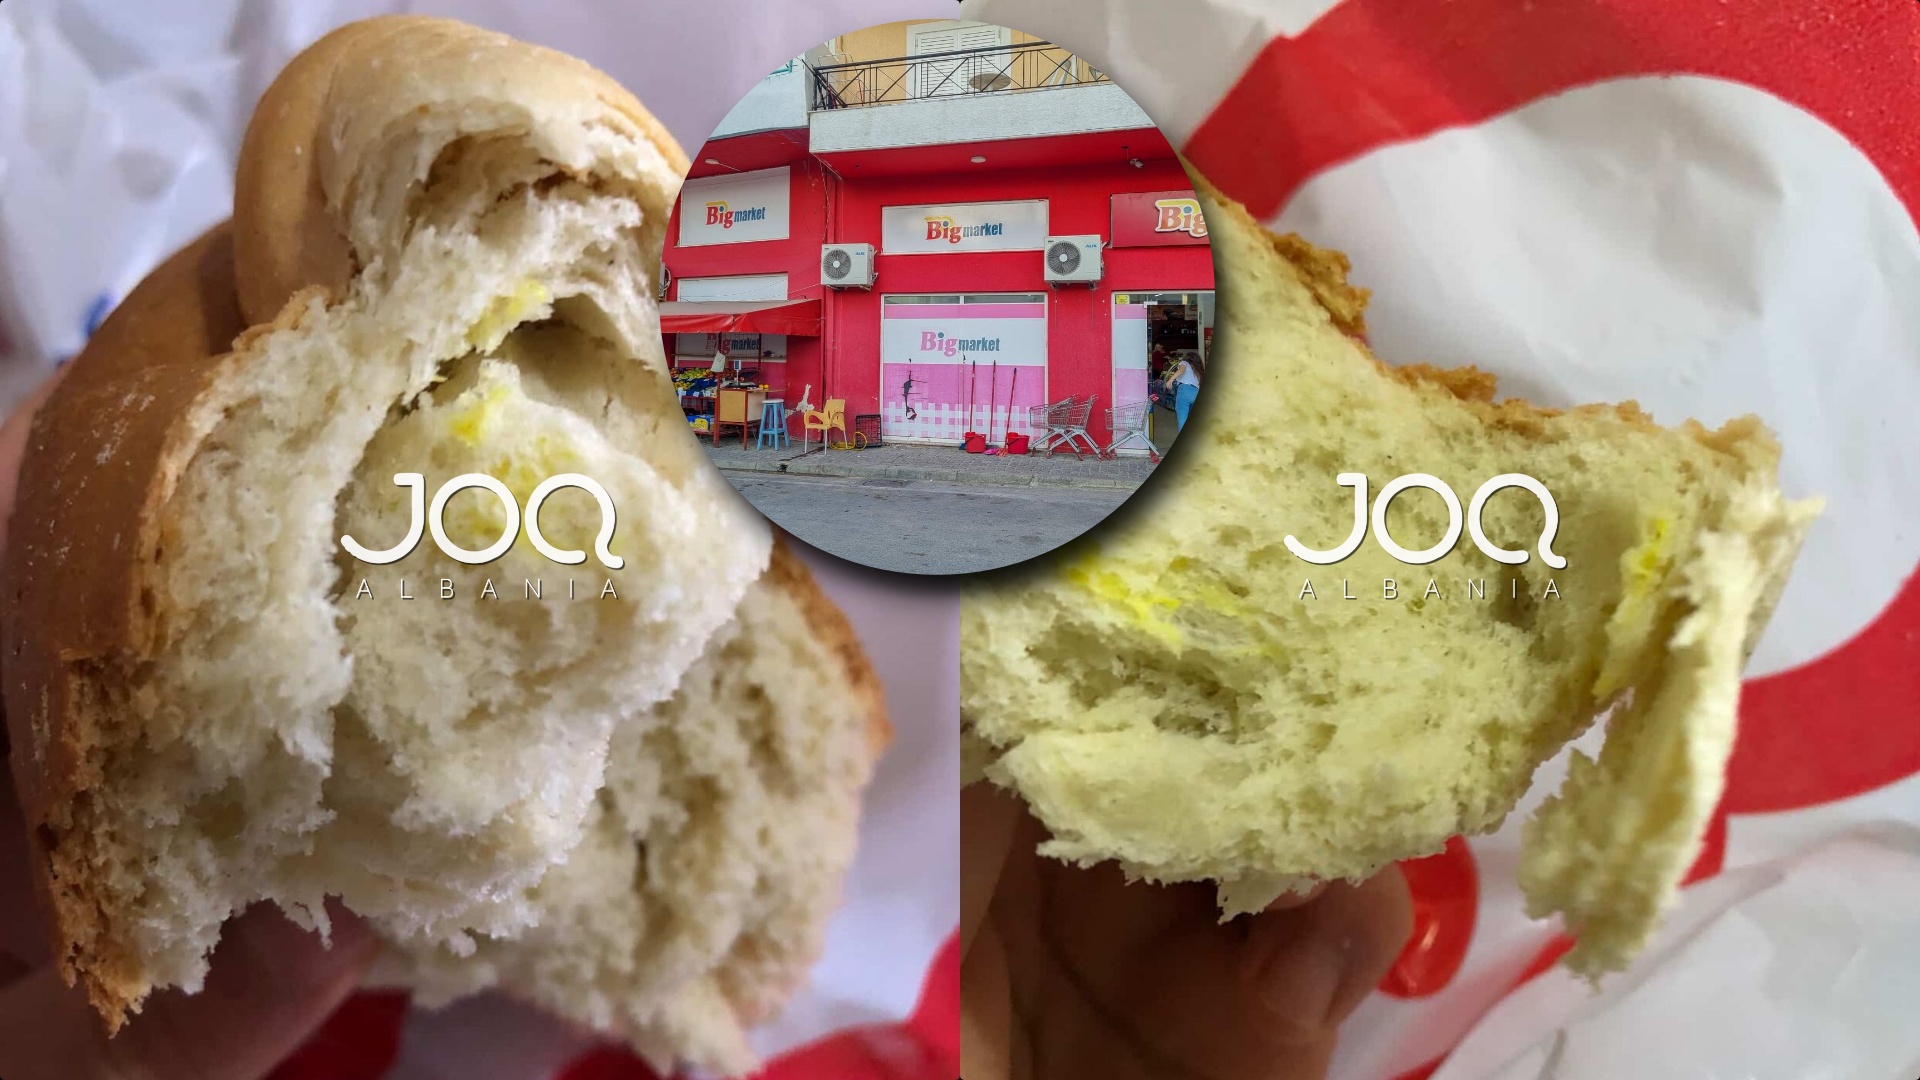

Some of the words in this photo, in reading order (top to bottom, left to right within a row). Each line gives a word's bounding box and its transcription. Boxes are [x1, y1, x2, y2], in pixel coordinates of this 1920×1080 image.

[705, 205, 734, 229] Big
[734, 207, 766, 222] market
[1157, 204, 1207, 236] Big
[926, 220, 962, 244] Big
[962, 222, 1003, 238] market
[920, 331, 958, 357] Big
[958, 337, 1000, 351] market
